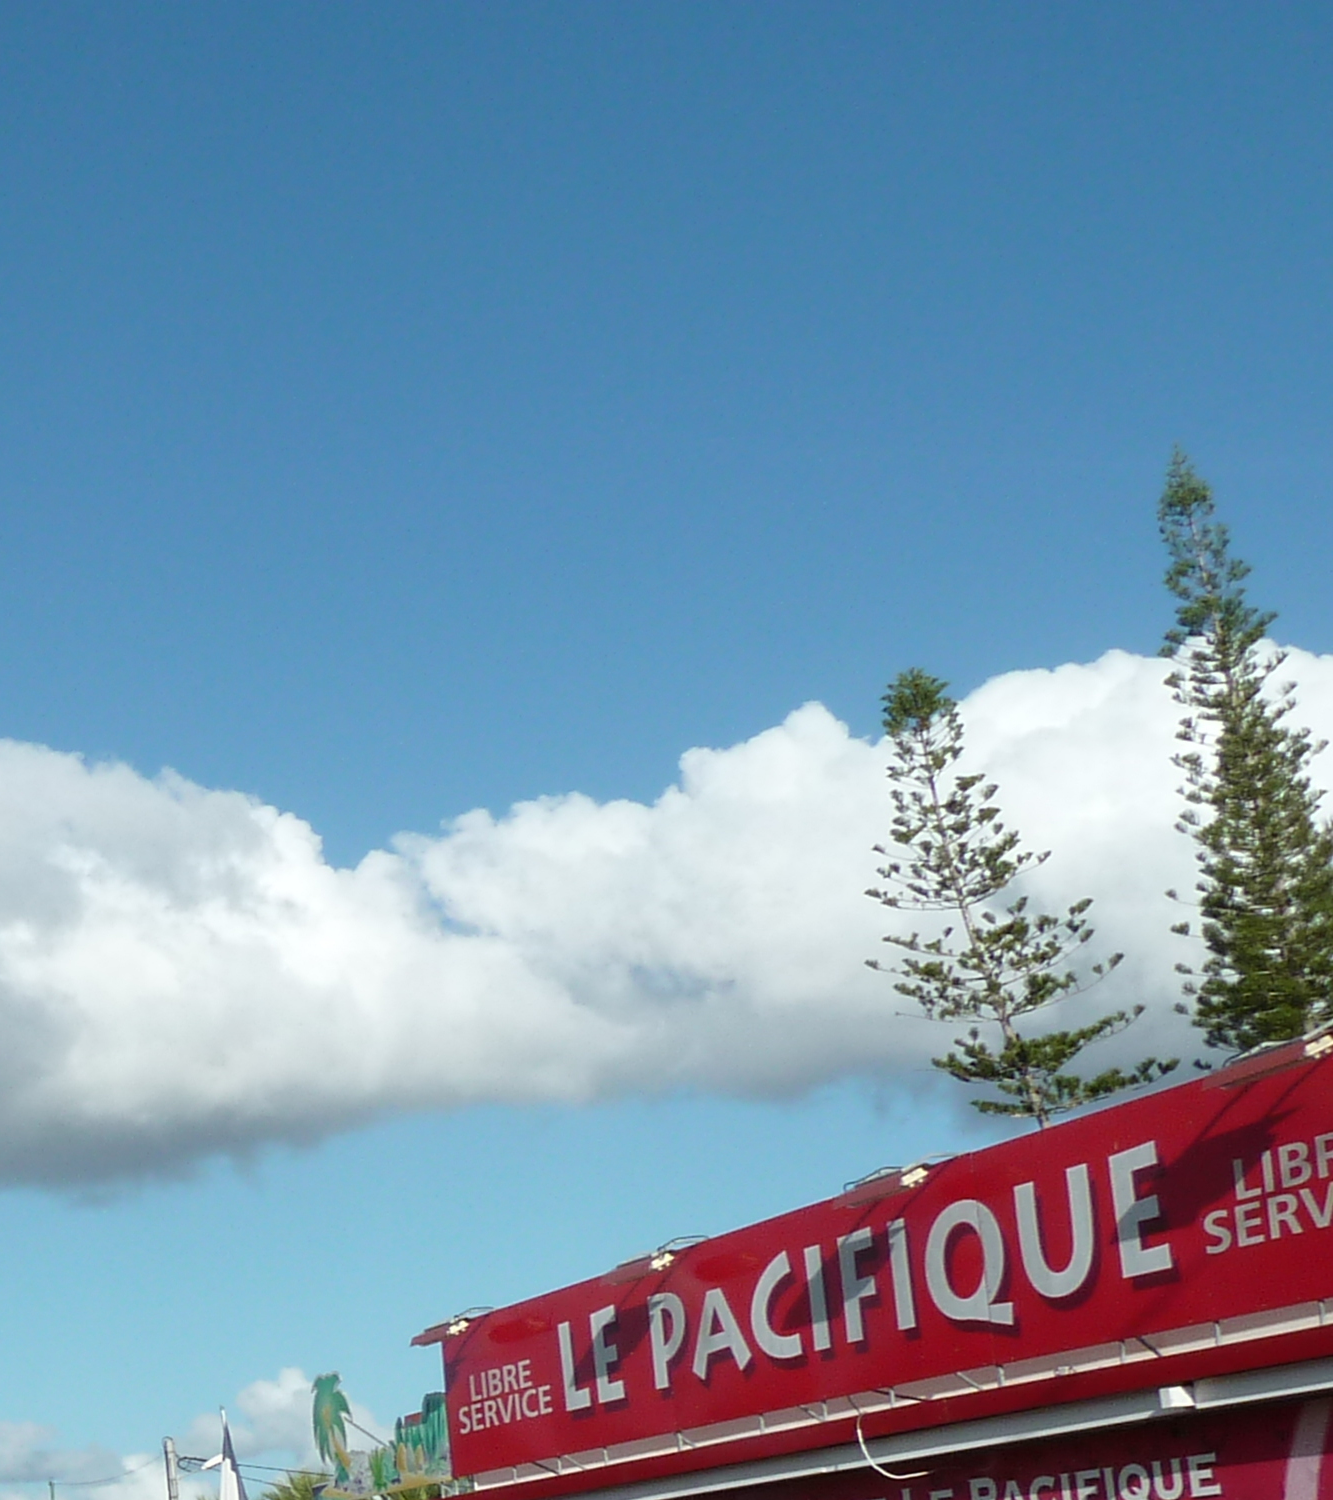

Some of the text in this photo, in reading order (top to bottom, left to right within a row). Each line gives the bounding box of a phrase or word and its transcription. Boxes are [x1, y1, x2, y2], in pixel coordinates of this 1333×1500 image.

[557, 1140, 1173, 1412] LE PACIFIQUE
[469, 1359, 533, 1402] LIBRE
[459, 1385, 553, 1435] SERVICE
